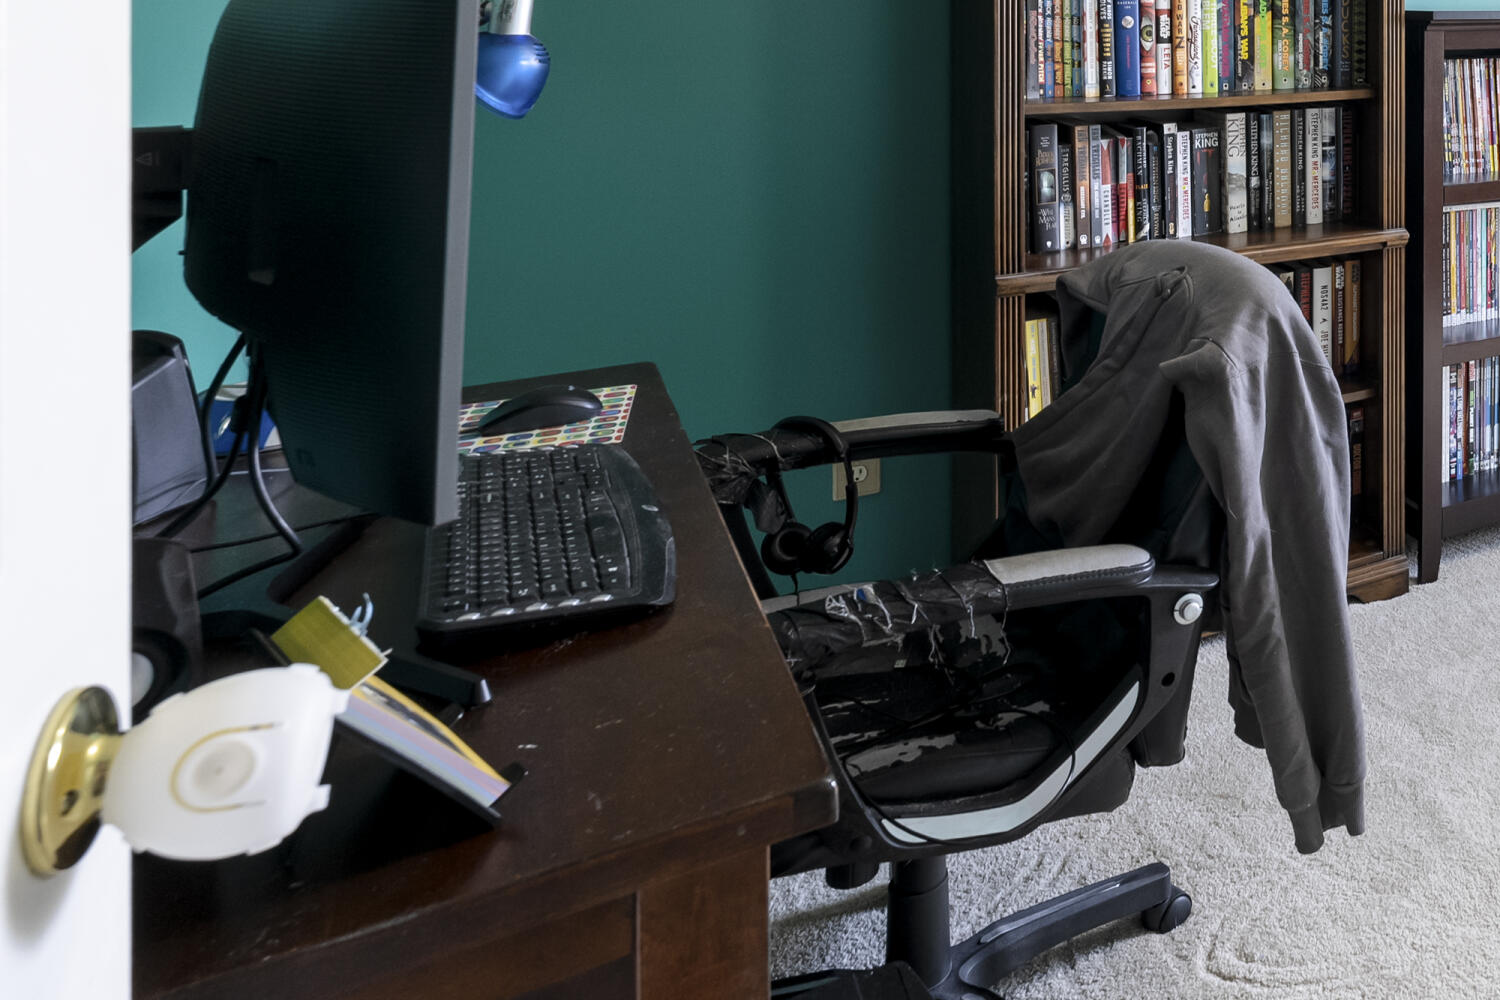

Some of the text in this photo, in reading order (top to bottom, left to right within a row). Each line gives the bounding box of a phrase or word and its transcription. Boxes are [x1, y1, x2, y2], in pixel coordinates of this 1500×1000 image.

[1176, 14, 1184, 35] WAR
[1282, 16, 1288, 25] S.
[1322, 16, 1328, 25] S.
[1282, 28, 1288, 37] A.
[1176, 36, 1185, 48] Z
[1240, 38, 1248, 60] WAR
[1222, 44, 1230, 78] WAKES
[1195, 138, 1218, 149] KING
[1228, 119, 1240, 158] KING
[1062, 153, 1070, 192] TREGILLIS
[1320, 284, 1328, 310] NOS4A2
[1320, 330, 1328, 343] JOE
